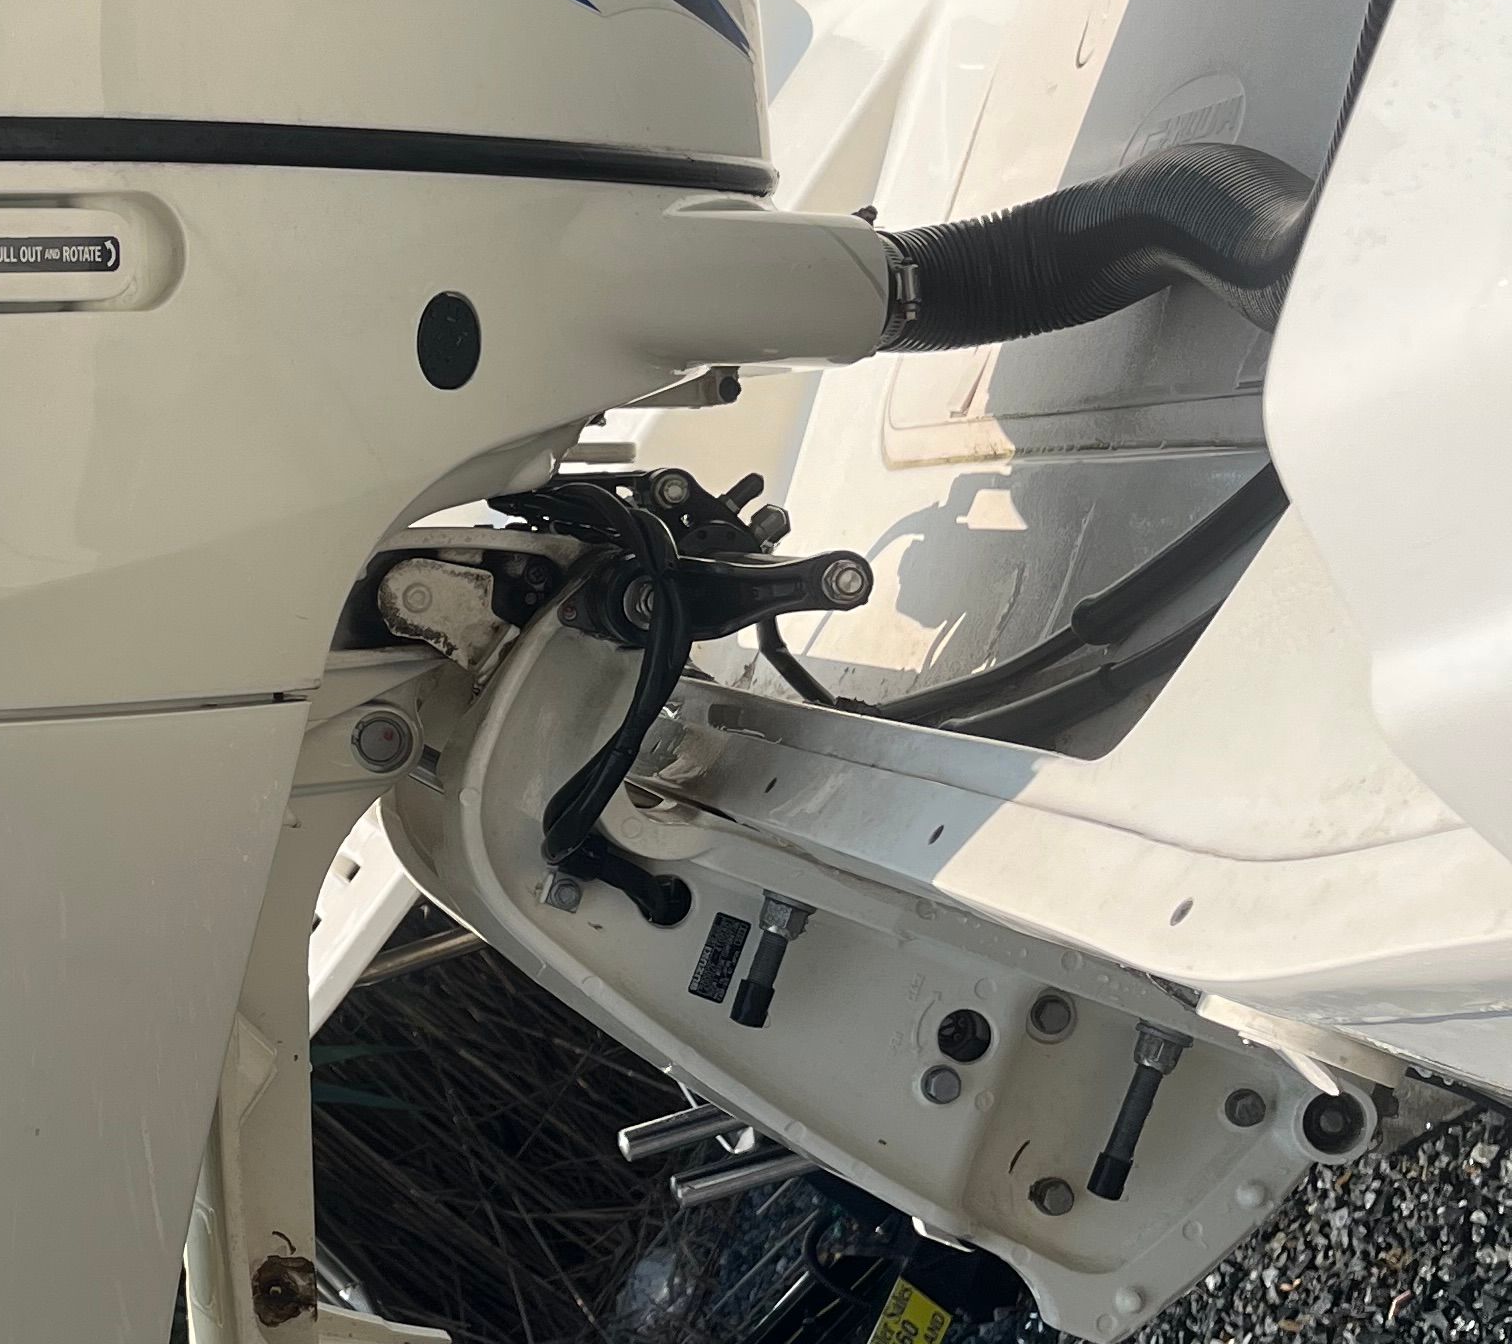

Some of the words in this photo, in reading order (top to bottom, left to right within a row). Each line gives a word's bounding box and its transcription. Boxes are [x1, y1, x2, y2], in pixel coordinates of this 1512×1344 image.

[20, 246, 43, 263] OUT
[44, 249, 61, 260] AND
[63, 245, 103, 262] ROTATE
[689, 945, 713, 991] SUZUKI
[882, 1281, 913, 1325] Sales
